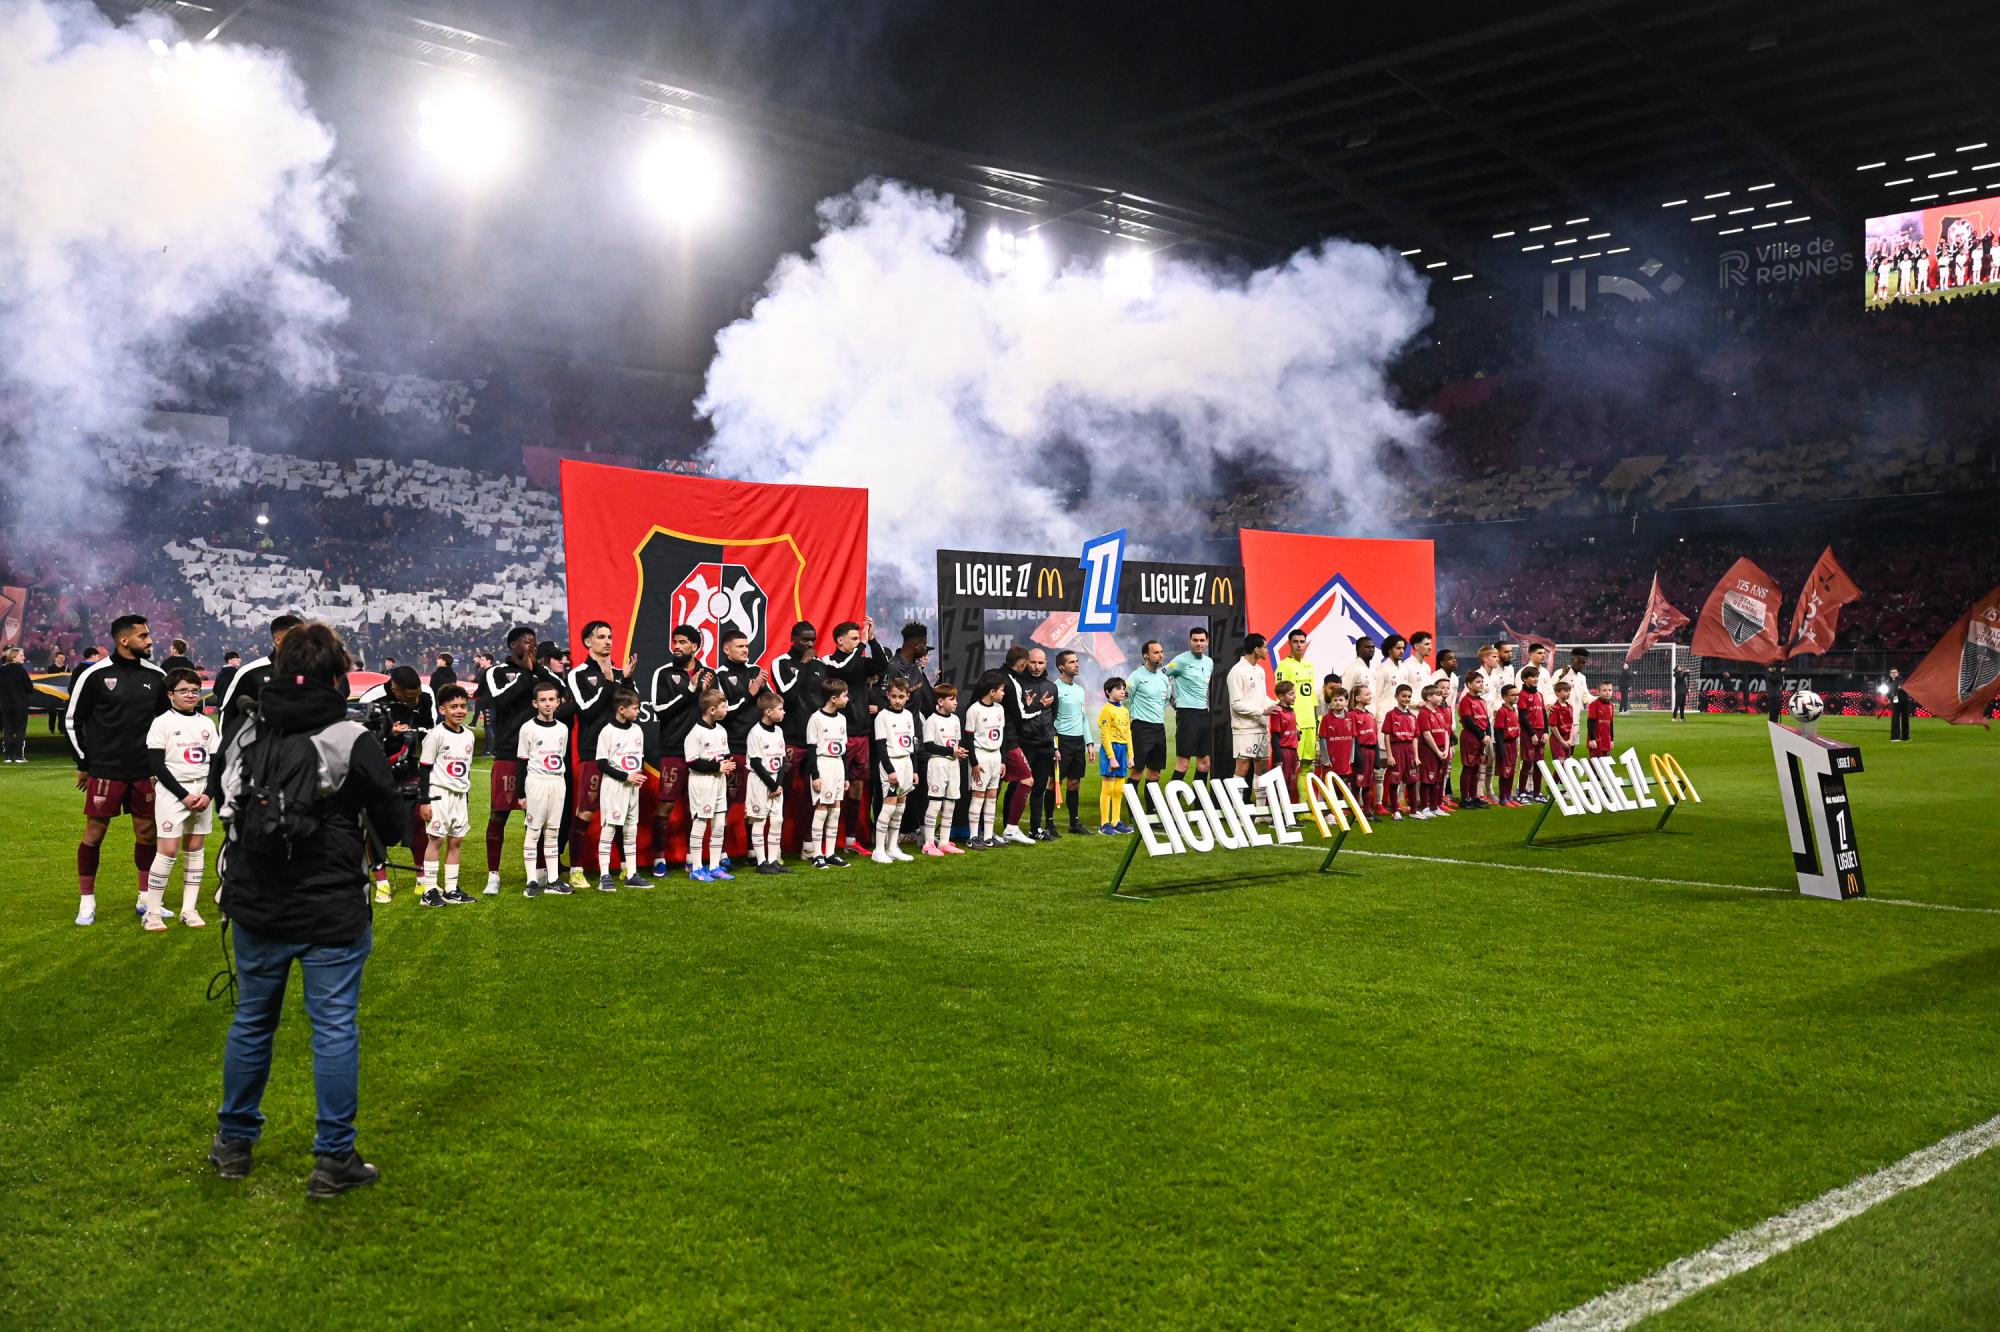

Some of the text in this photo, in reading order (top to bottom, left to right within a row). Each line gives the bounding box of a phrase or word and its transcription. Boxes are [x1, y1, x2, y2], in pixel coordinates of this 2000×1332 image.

[1756, 237, 1834, 263] Ville de
[1749, 584, 1769, 599] ANS
[996, 609, 1047, 620] SUPER
[502, 775, 516, 792] 18
[590, 775, 600, 790] 9
